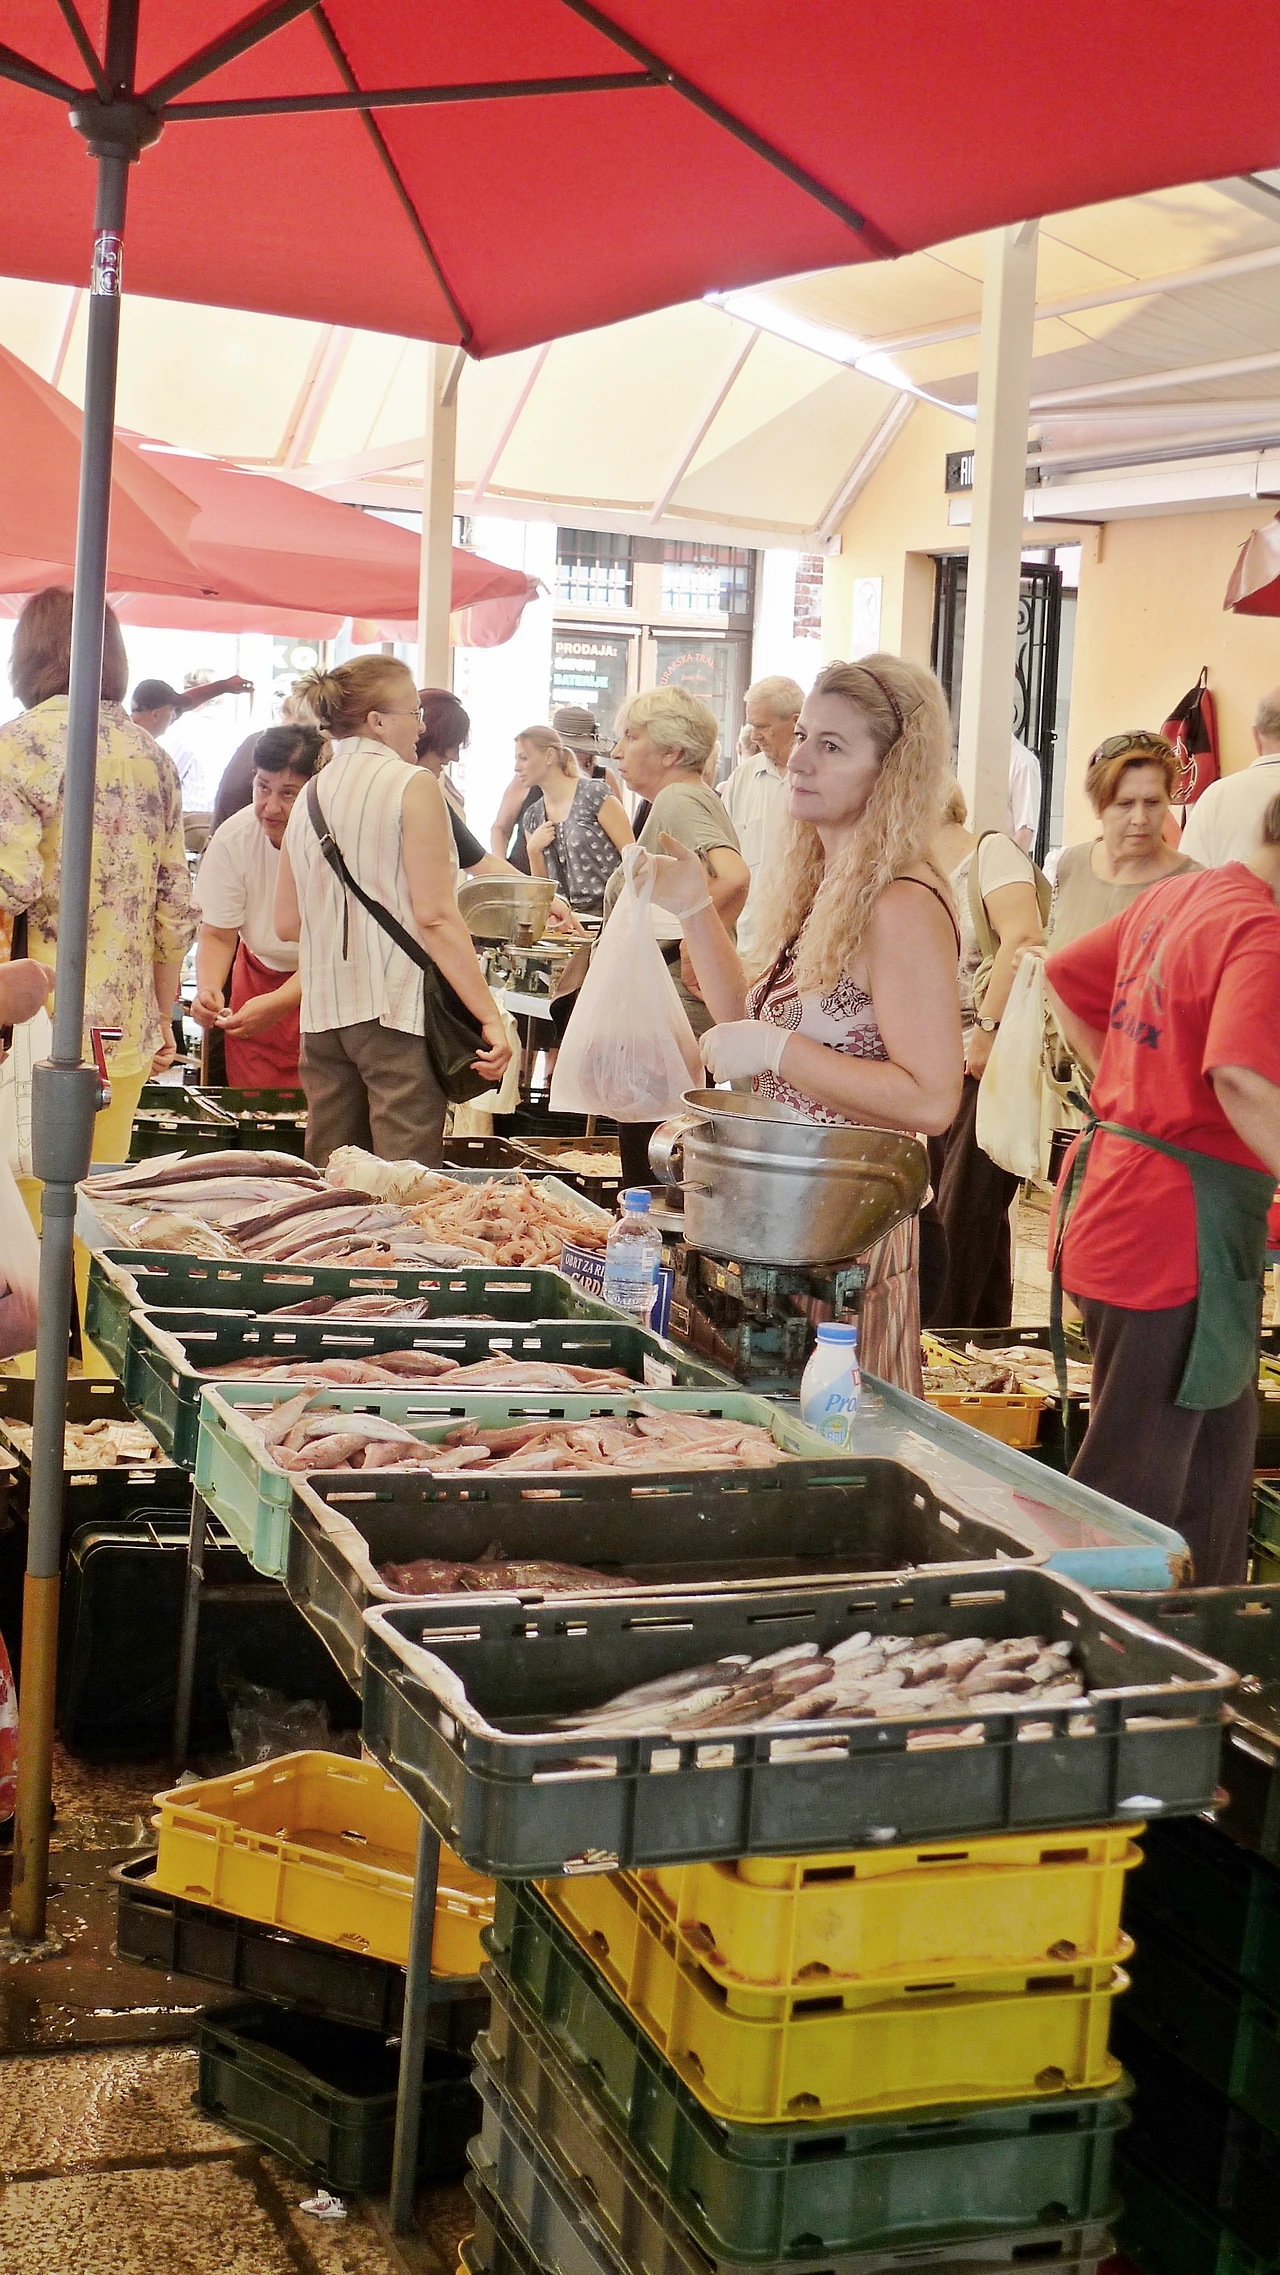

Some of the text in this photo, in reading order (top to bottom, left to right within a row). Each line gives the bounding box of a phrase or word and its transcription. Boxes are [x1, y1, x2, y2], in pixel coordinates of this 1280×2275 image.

[555, 641, 618, 657] PRODAJA:
[565, 1253, 605, 1277] OBRT ZA RI
[824, 1393, 859, 1413] Pro
